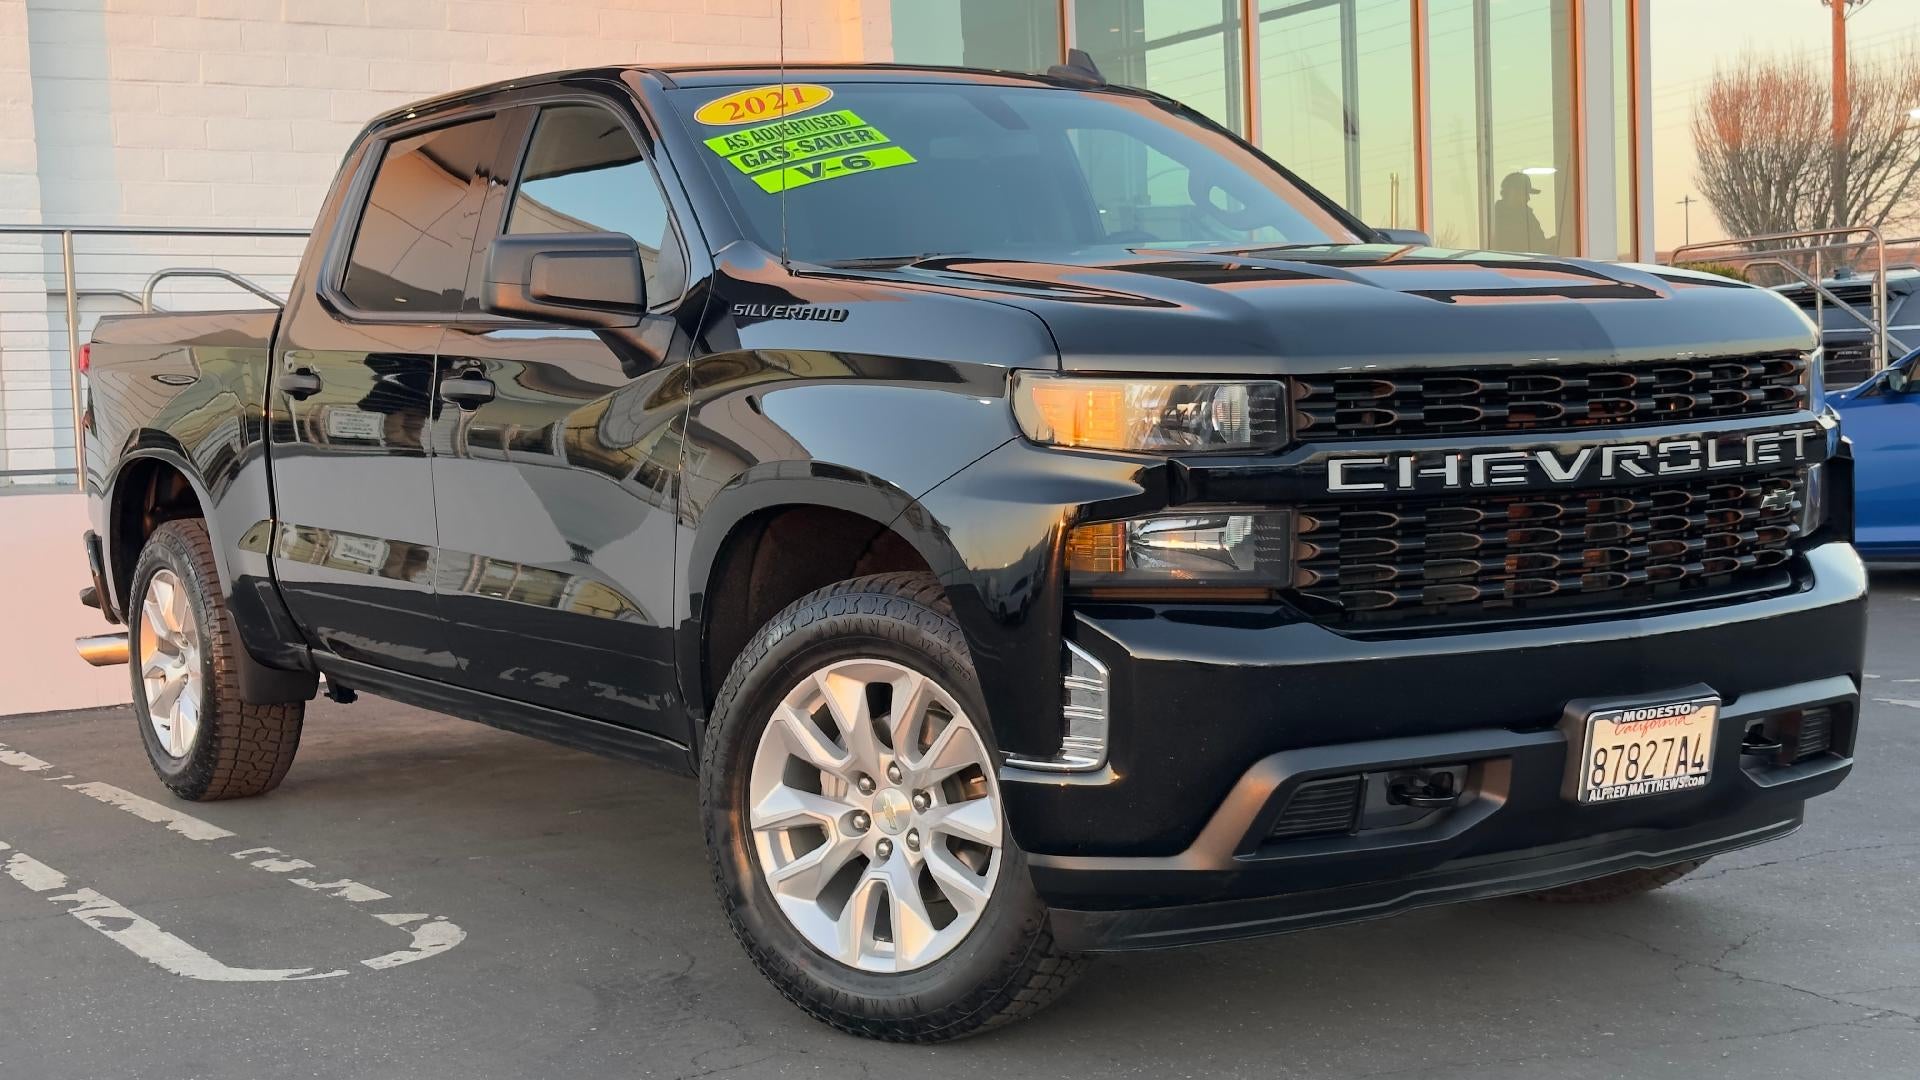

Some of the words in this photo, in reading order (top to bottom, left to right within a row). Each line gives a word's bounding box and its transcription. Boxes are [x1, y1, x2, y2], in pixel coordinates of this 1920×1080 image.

[722, 87, 808, 121] 2021
[723, 133, 749, 151] AS
[752, 114, 847, 145] ADVERTISED
[740, 129, 874, 169] GAS-SAVER
[794, 155, 873, 179] V-6
[732, 303, 848, 321] SILVERADO
[1327, 428, 1816, 492] CHEVROLET
[1622, 703, 1690, 723] MODESTO
[1591, 733, 1705, 787] 87827A4
